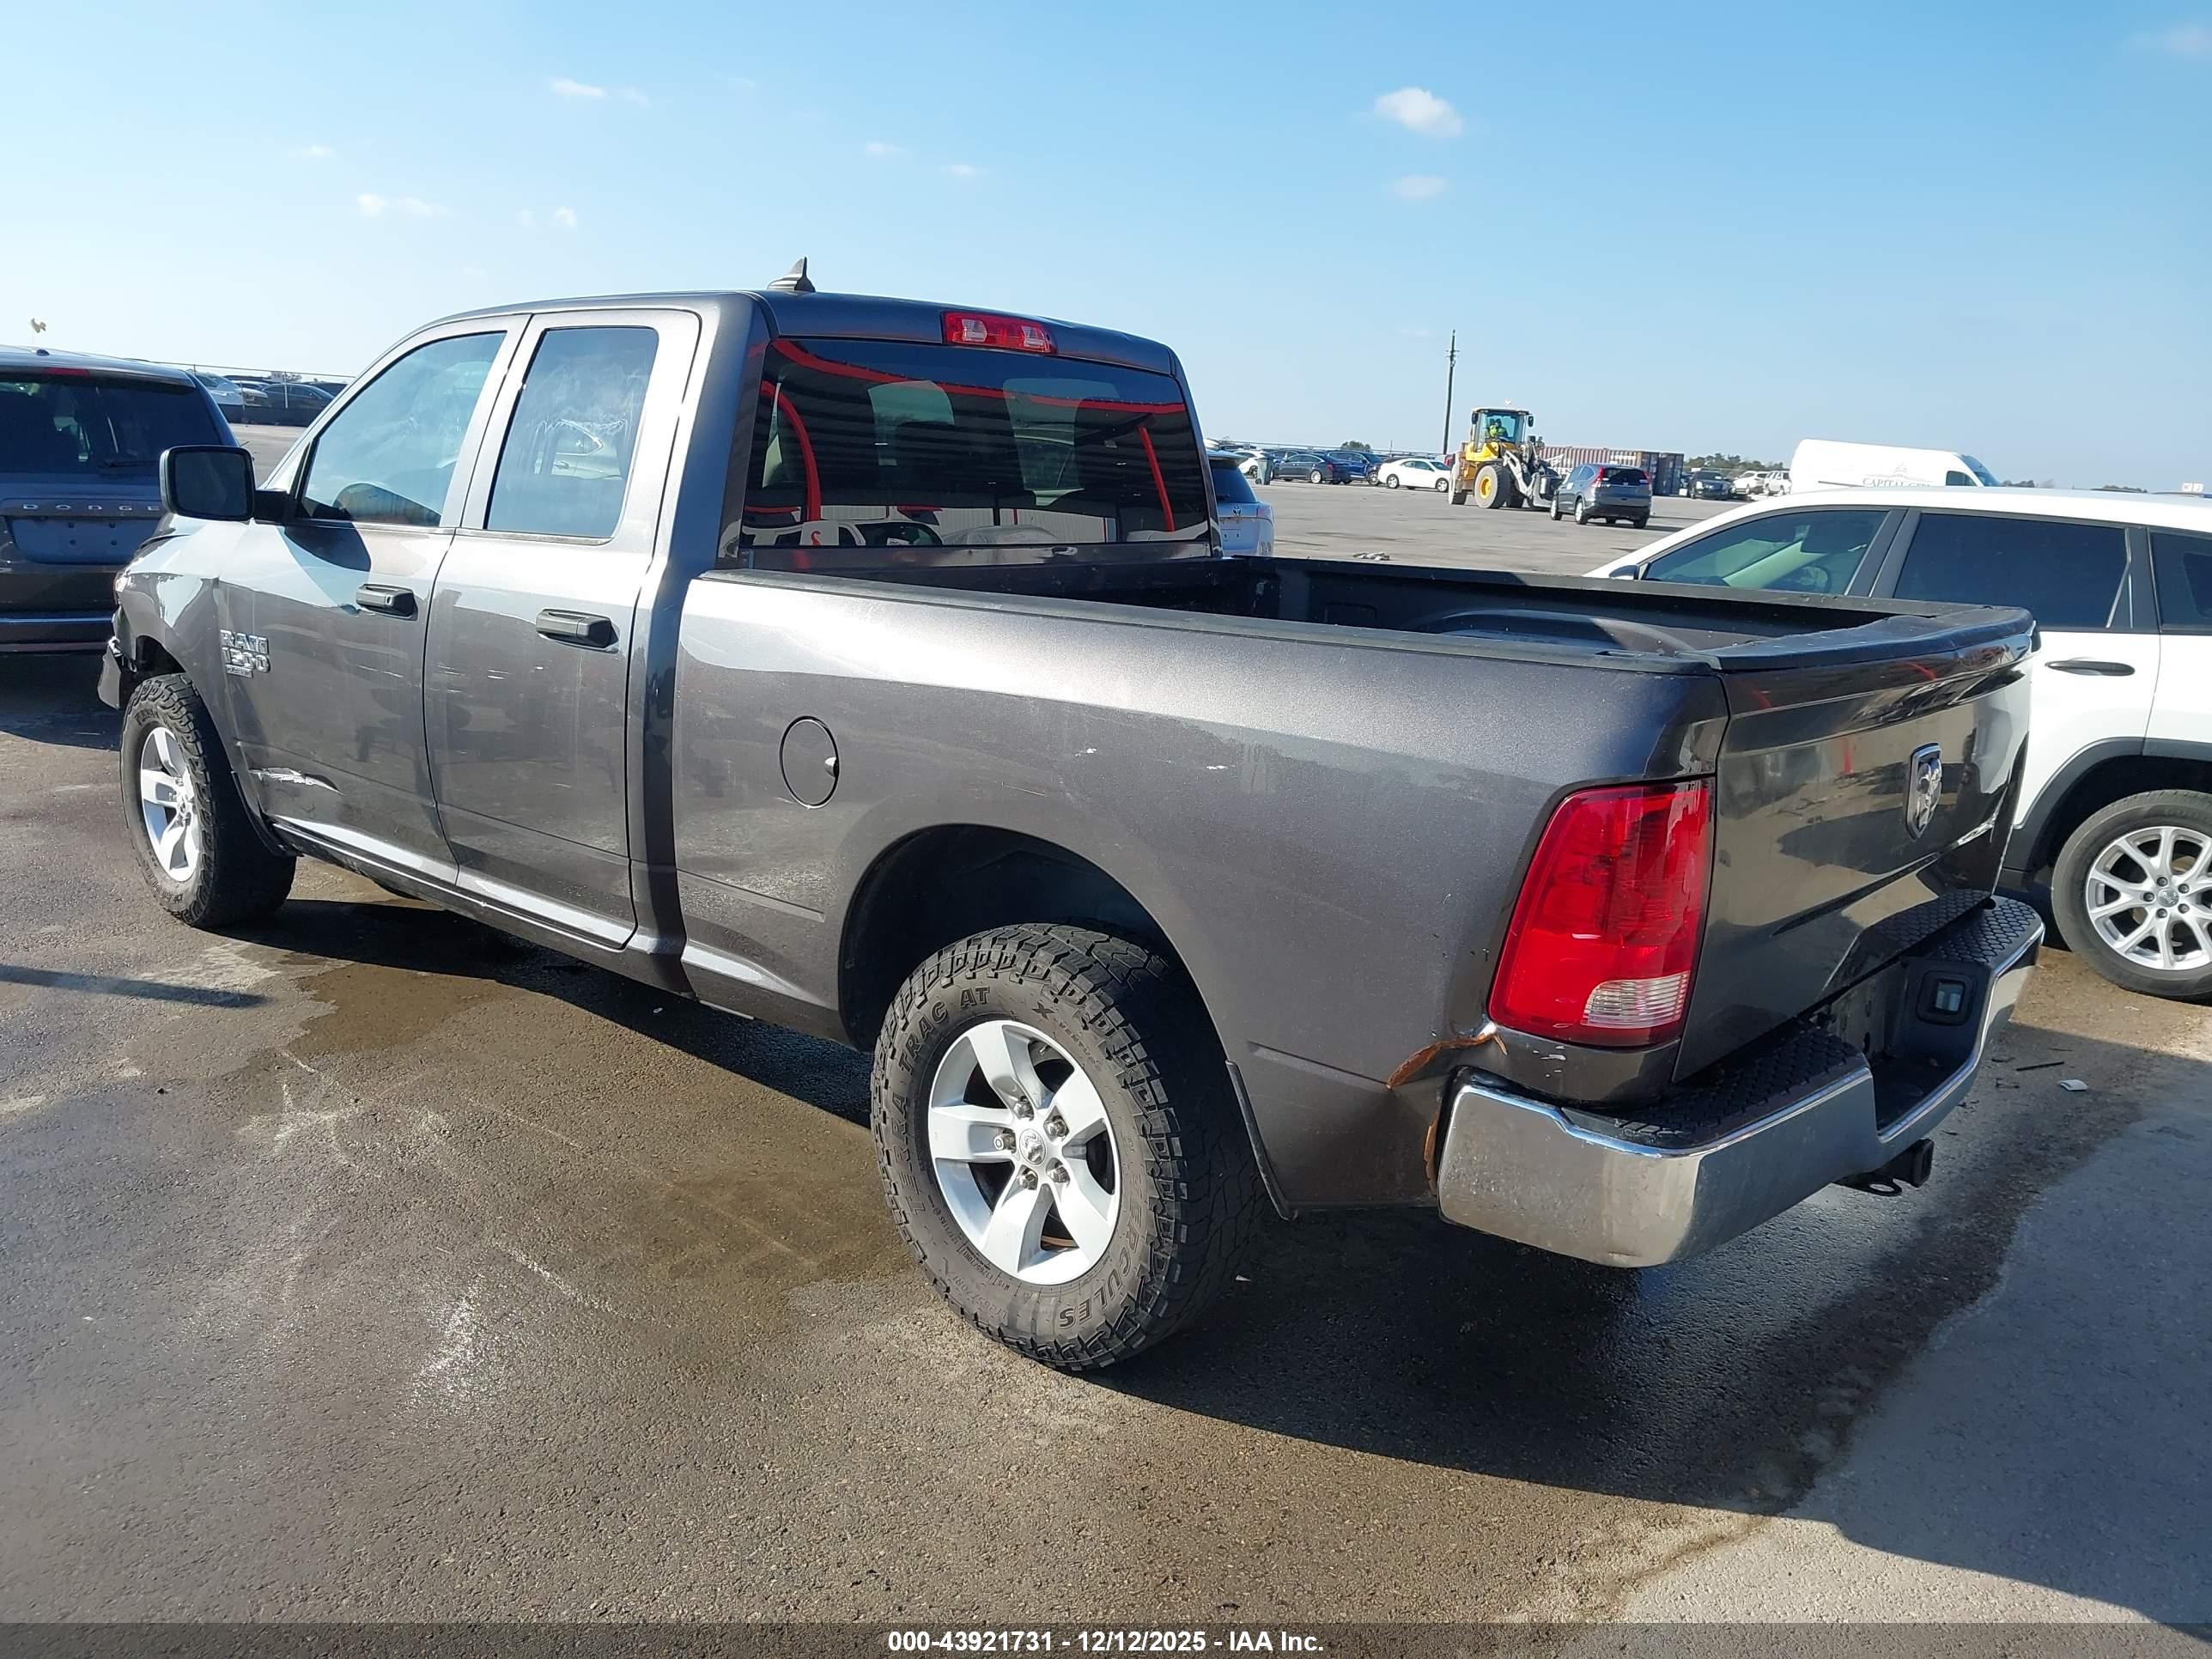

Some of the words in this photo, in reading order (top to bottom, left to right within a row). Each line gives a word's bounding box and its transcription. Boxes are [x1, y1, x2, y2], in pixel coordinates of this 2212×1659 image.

[1863, 476, 1904, 489] CAPITAL
[220, 629, 269, 654] RAM
[222, 647, 270, 672] 1500
[961, 987, 991, 1007] AT
[898, 1001, 948, 1076] TRAC
[892, 1091, 926, 1216] TERRA
[1059, 1172, 1143, 1328] HERCULES
